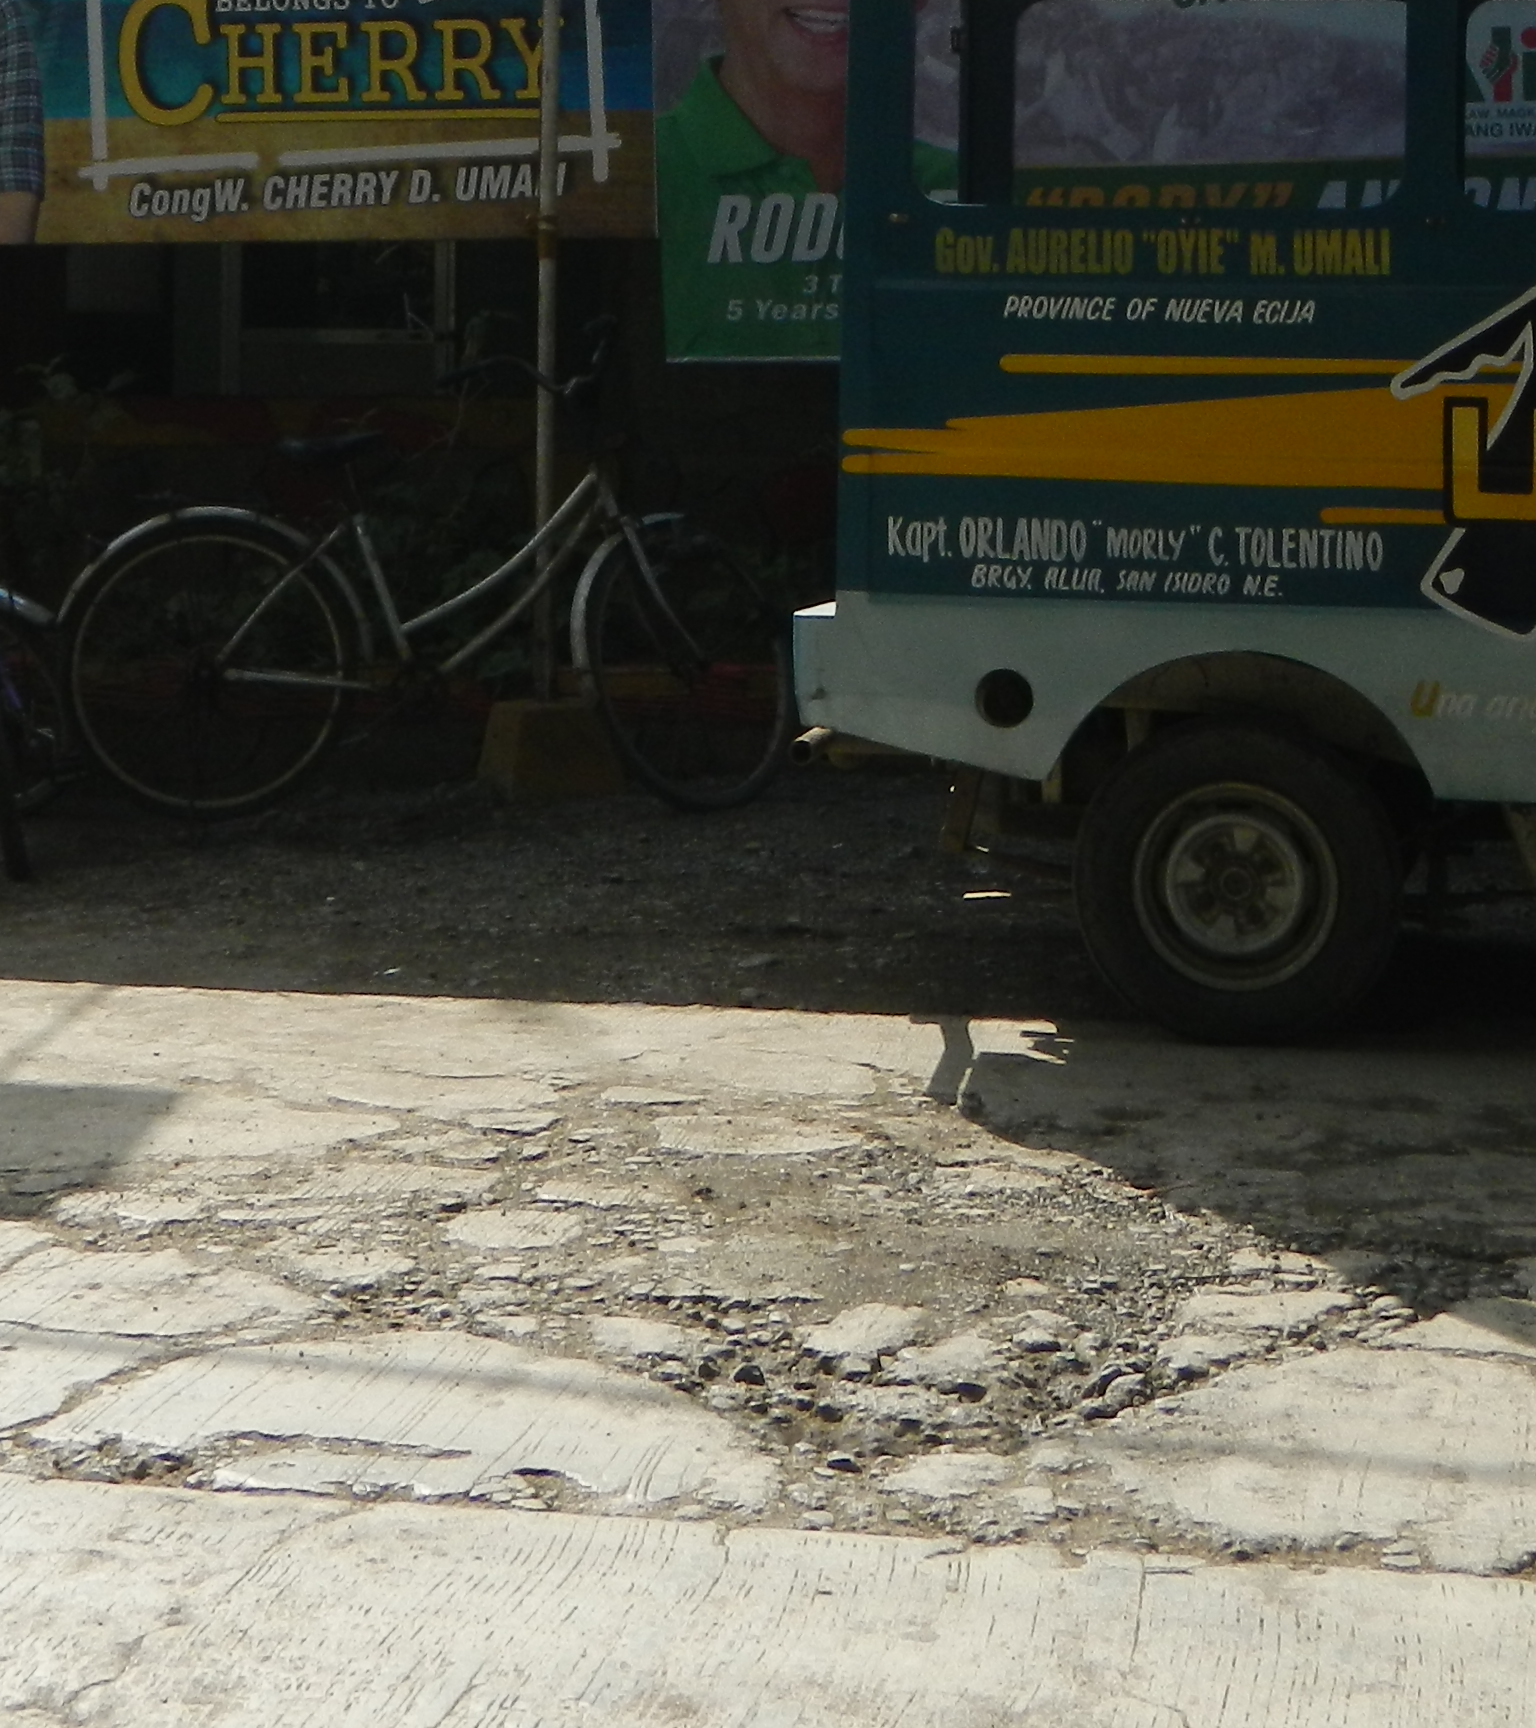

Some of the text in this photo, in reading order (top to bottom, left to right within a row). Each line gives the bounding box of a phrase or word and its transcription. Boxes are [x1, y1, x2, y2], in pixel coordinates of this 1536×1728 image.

[129, 161, 568, 223] CongW. CHERRY D. UMAI
[706, 191, 844, 264] ROD
[934, 228, 1000, 275] Gov.
[1005, 227, 1135, 275] AURELIO
[1248, 231, 1286, 275] M.
[1293, 228, 1393, 276] UMALI
[802, 274, 819, 294] 3
[726, 298, 840, 321] 5 Years
[1003, 294, 1317, 324] PROVINCE OF NUEVA ECIJA
[887, 515, 954, 563] Kapt.
[958, 517, 1088, 563] ORLANDO
[1207, 525, 1230, 568] C.
[1235, 525, 1384, 571] TOLENTINO
[1115, 569, 1157, 593] SAN
[1163, 571, 1231, 596] ISIDRO
[1242, 574, 1284, 598] N.E.
[1409, 680, 1476, 720] Una
